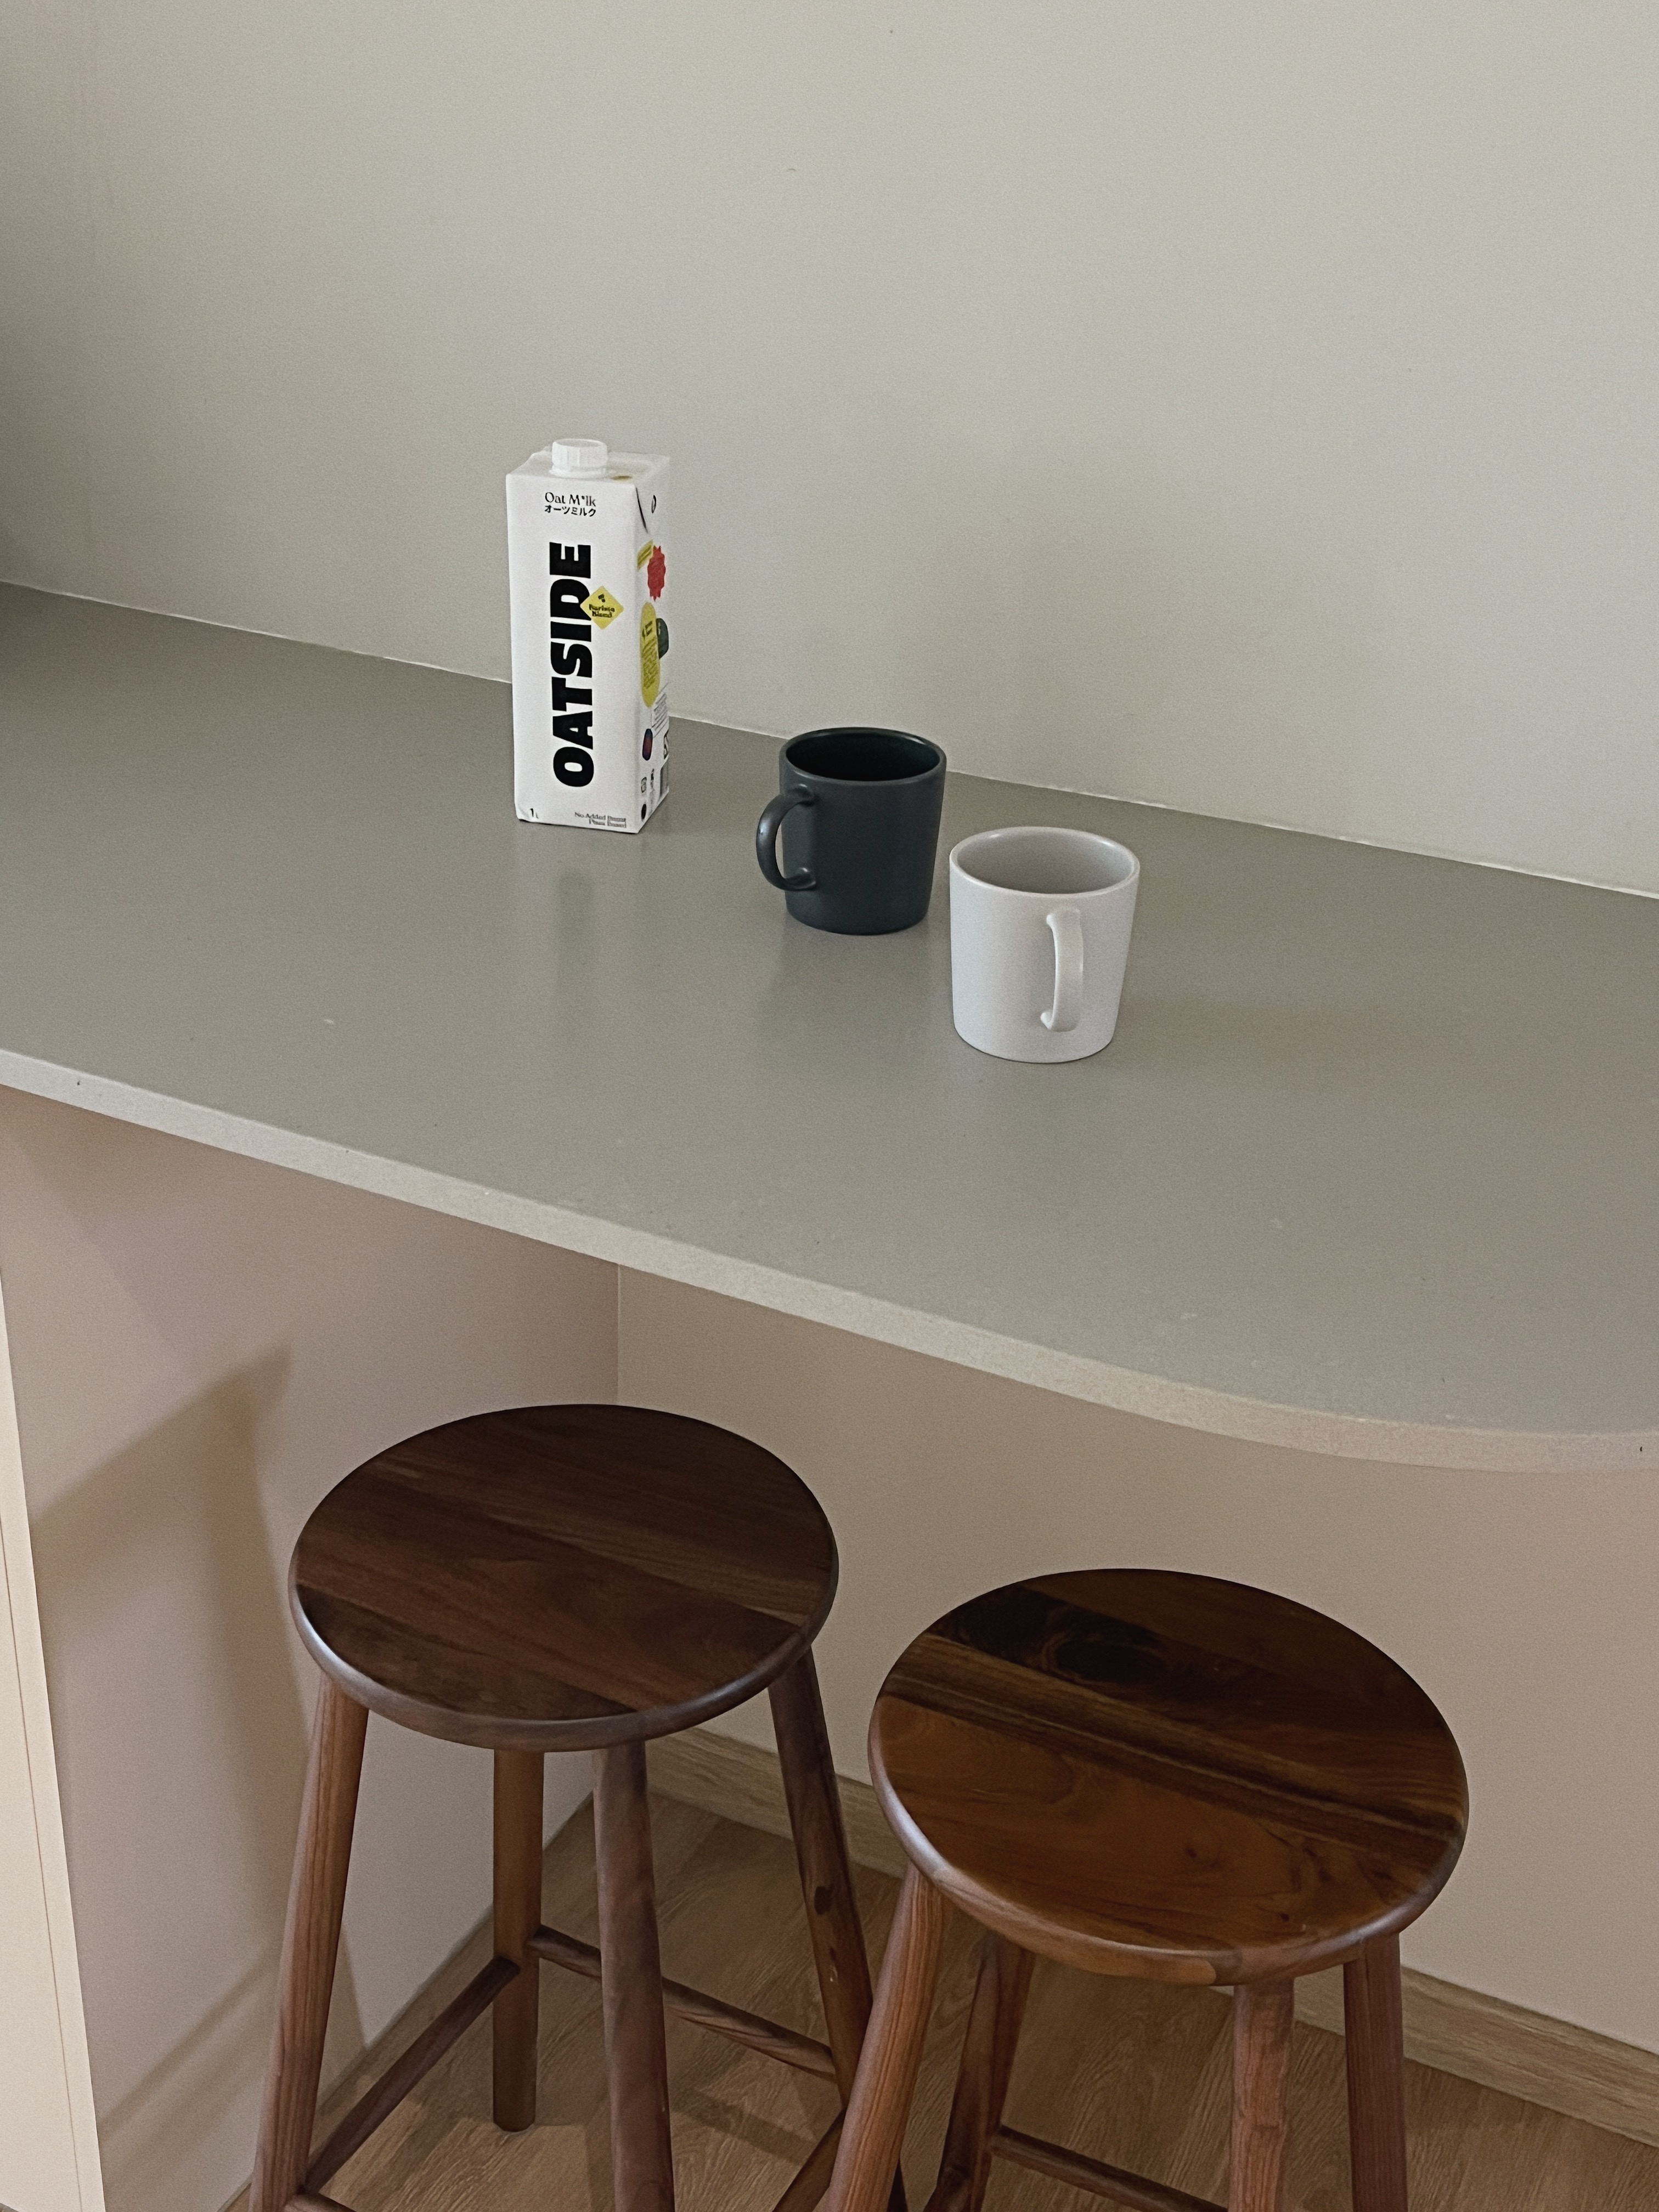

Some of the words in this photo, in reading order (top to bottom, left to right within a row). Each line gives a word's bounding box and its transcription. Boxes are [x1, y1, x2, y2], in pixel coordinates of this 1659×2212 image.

[545, 492, 566, 503] Oat
[544, 505, 596, 517] オーツミルク
[549, 541, 594, 787] OATSIDE
